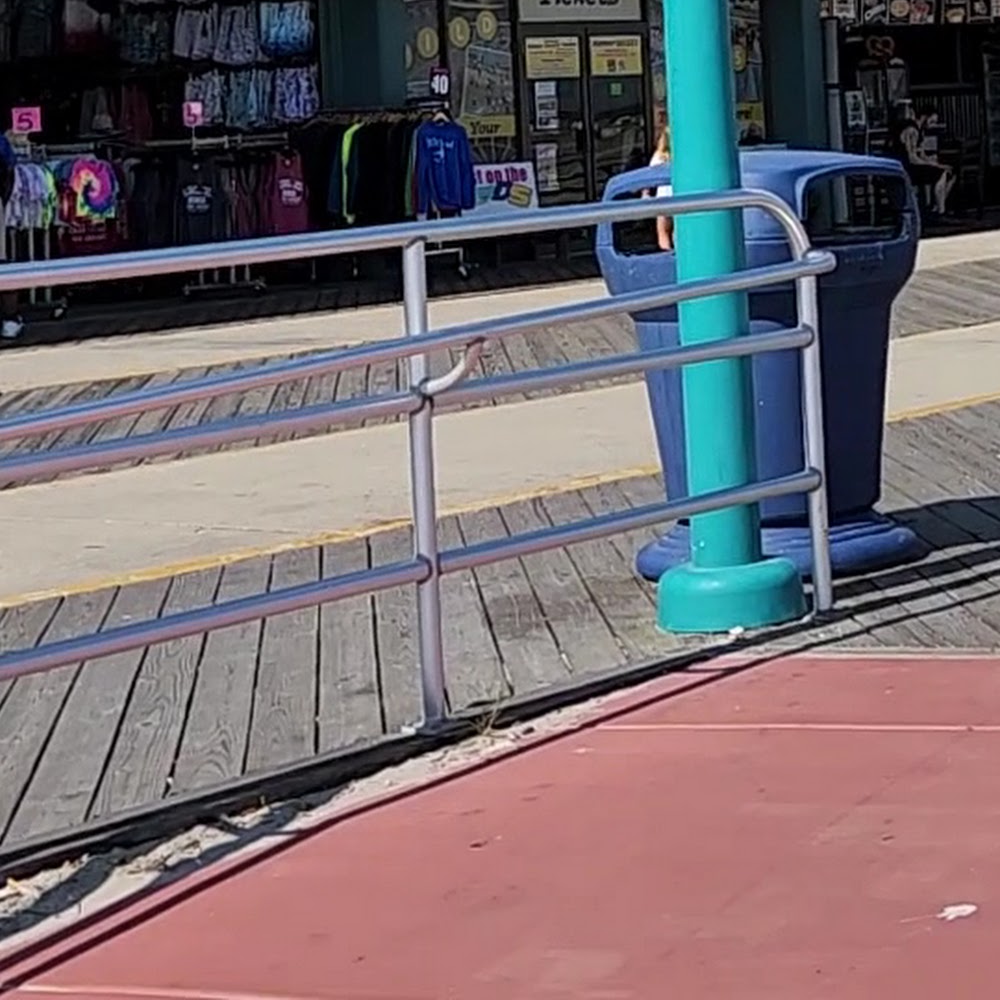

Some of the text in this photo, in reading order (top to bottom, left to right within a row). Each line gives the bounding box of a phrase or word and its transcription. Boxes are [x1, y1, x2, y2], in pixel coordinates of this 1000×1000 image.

[15, 112, 34, 131] 5
[469, 120, 501, 136] Your
[504, 167, 528, 182] the
